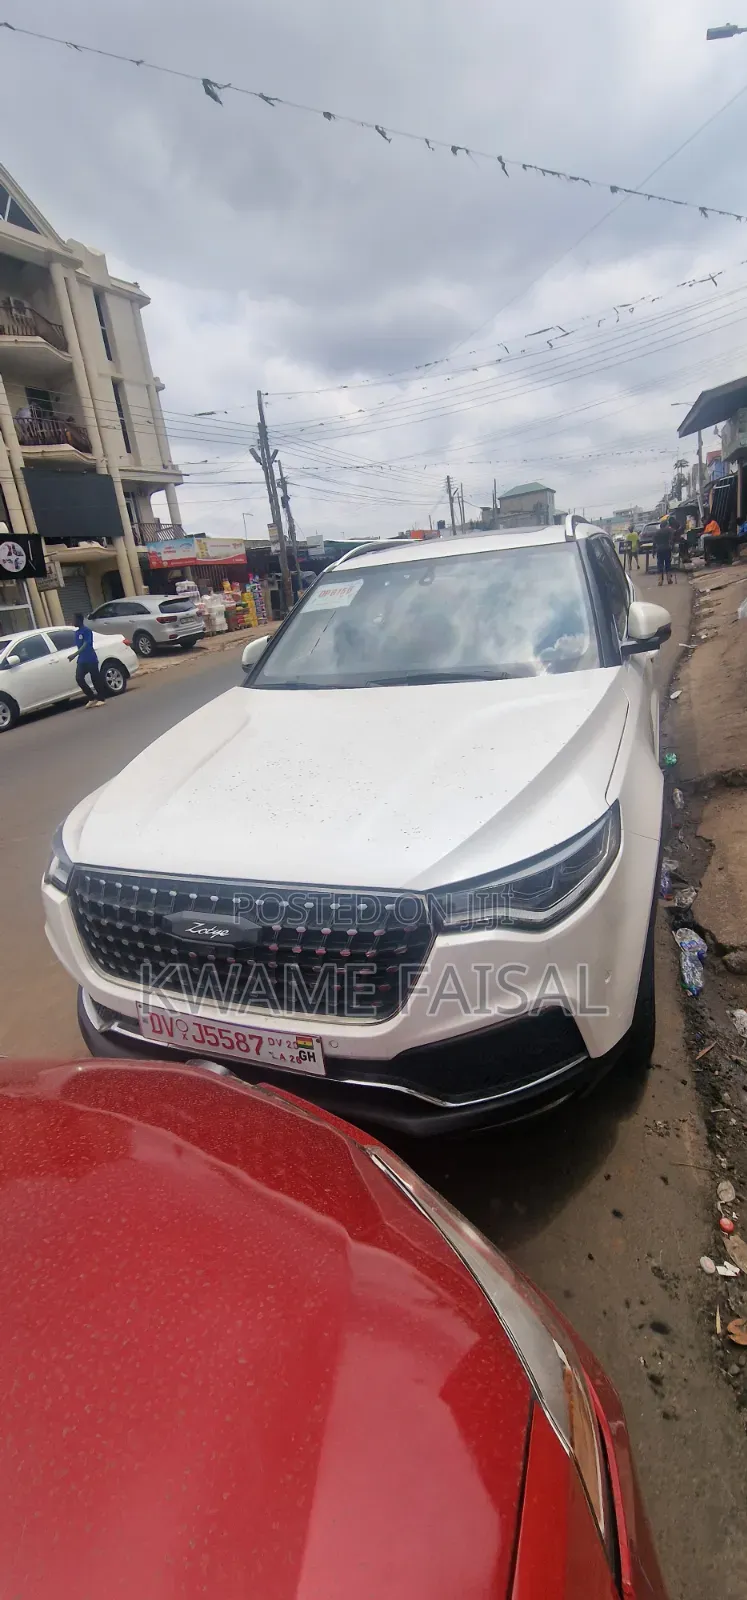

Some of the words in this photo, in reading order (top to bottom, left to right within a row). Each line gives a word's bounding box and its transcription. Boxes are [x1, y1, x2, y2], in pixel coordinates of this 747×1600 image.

[150, 1012, 174, 1038] DV
[192, 1022, 263, 1056] J5587
[267, 1037, 282, 1048] DV
[299, 1050, 316, 1062] GH
